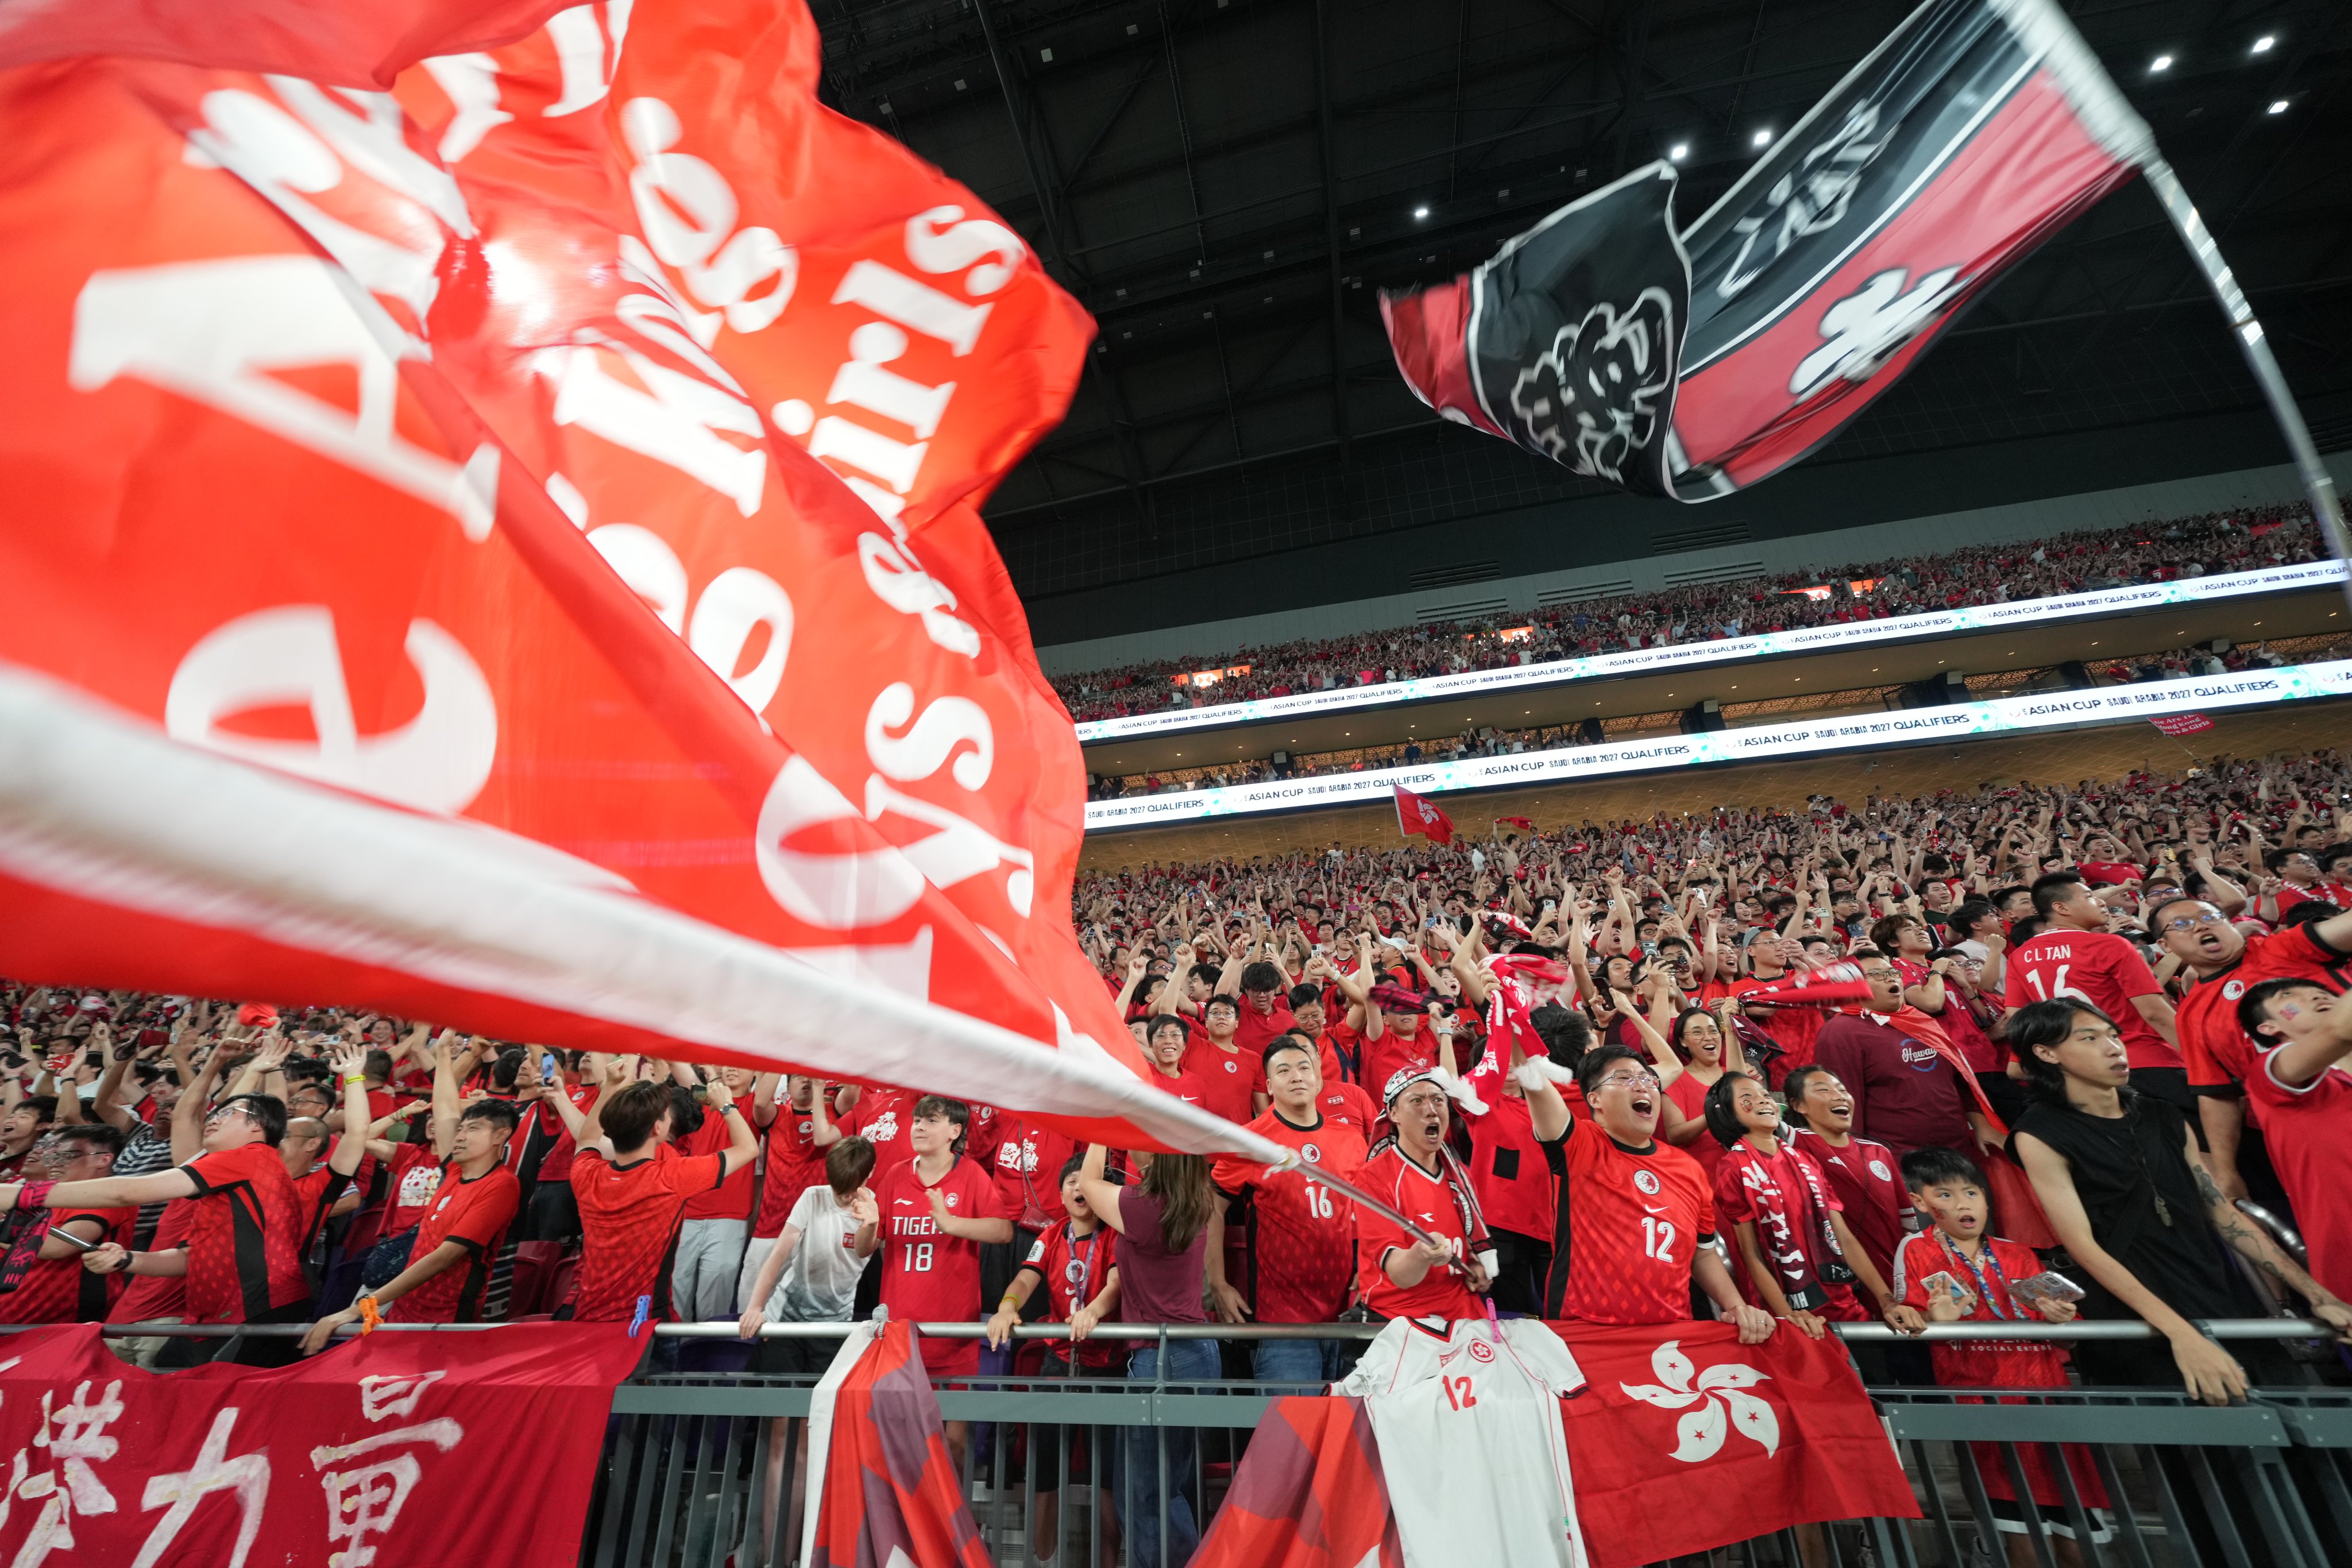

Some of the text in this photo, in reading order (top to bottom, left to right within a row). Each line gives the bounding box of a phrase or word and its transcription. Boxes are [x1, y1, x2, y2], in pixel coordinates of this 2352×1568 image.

[773, 204, 1027, 543] irls
[2206, 581, 2235, 590] ASIAN
[2237, 578, 2258, 586] CUP
[1993, 609, 2021, 617] ASIAN
[2105, 590, 2161, 603] QUALIFIERS
[1795, 634, 1821, 643] ASIAN
[1899, 617, 1952, 629] QUALIFIERS
[1609, 658, 1634, 666] ASIAN
[1708, 643, 1756, 654] QUALIFIERS
[1528, 666, 1573, 677] QUALIFIERS
[1360, 688, 1402, 698] QUALIFIERS
[2030, 679, 2278, 715] ASIAN CUP SAUDI ARABIA 2027 QUALIFIERS
[165, 604, 499, 820] e
[1202, 709, 1242, 719] QUALIFIERS
[2179, 717, 2202, 727] Kong
[2189, 720, 2210, 730] Girls
[1744, 714, 1969, 746] ASIAN CUP SAUDI ARABIA 2027 QUALIFIERS
[1485, 745, 1689, 775] ASIAN CUP SAUDI ARABIA 2027 QUALIFIERS
[1249, 773, 1435, 801] ASIAN CUP SAUDI ARABIA 2027 QUALIFIERS
[1088, 799, 1203, 818] SAUDI ARABIA 2027 QUALIFIERS
[755, 680, 1035, 1004] oys
[2023, 944, 2071, 963] C L TAN
[1305, 1186, 1334, 1219] 16
[1641, 1216, 1676, 1263] 12
[905, 1243, 934, 1272] 18
[1442, 1375, 1477, 1411] 12
